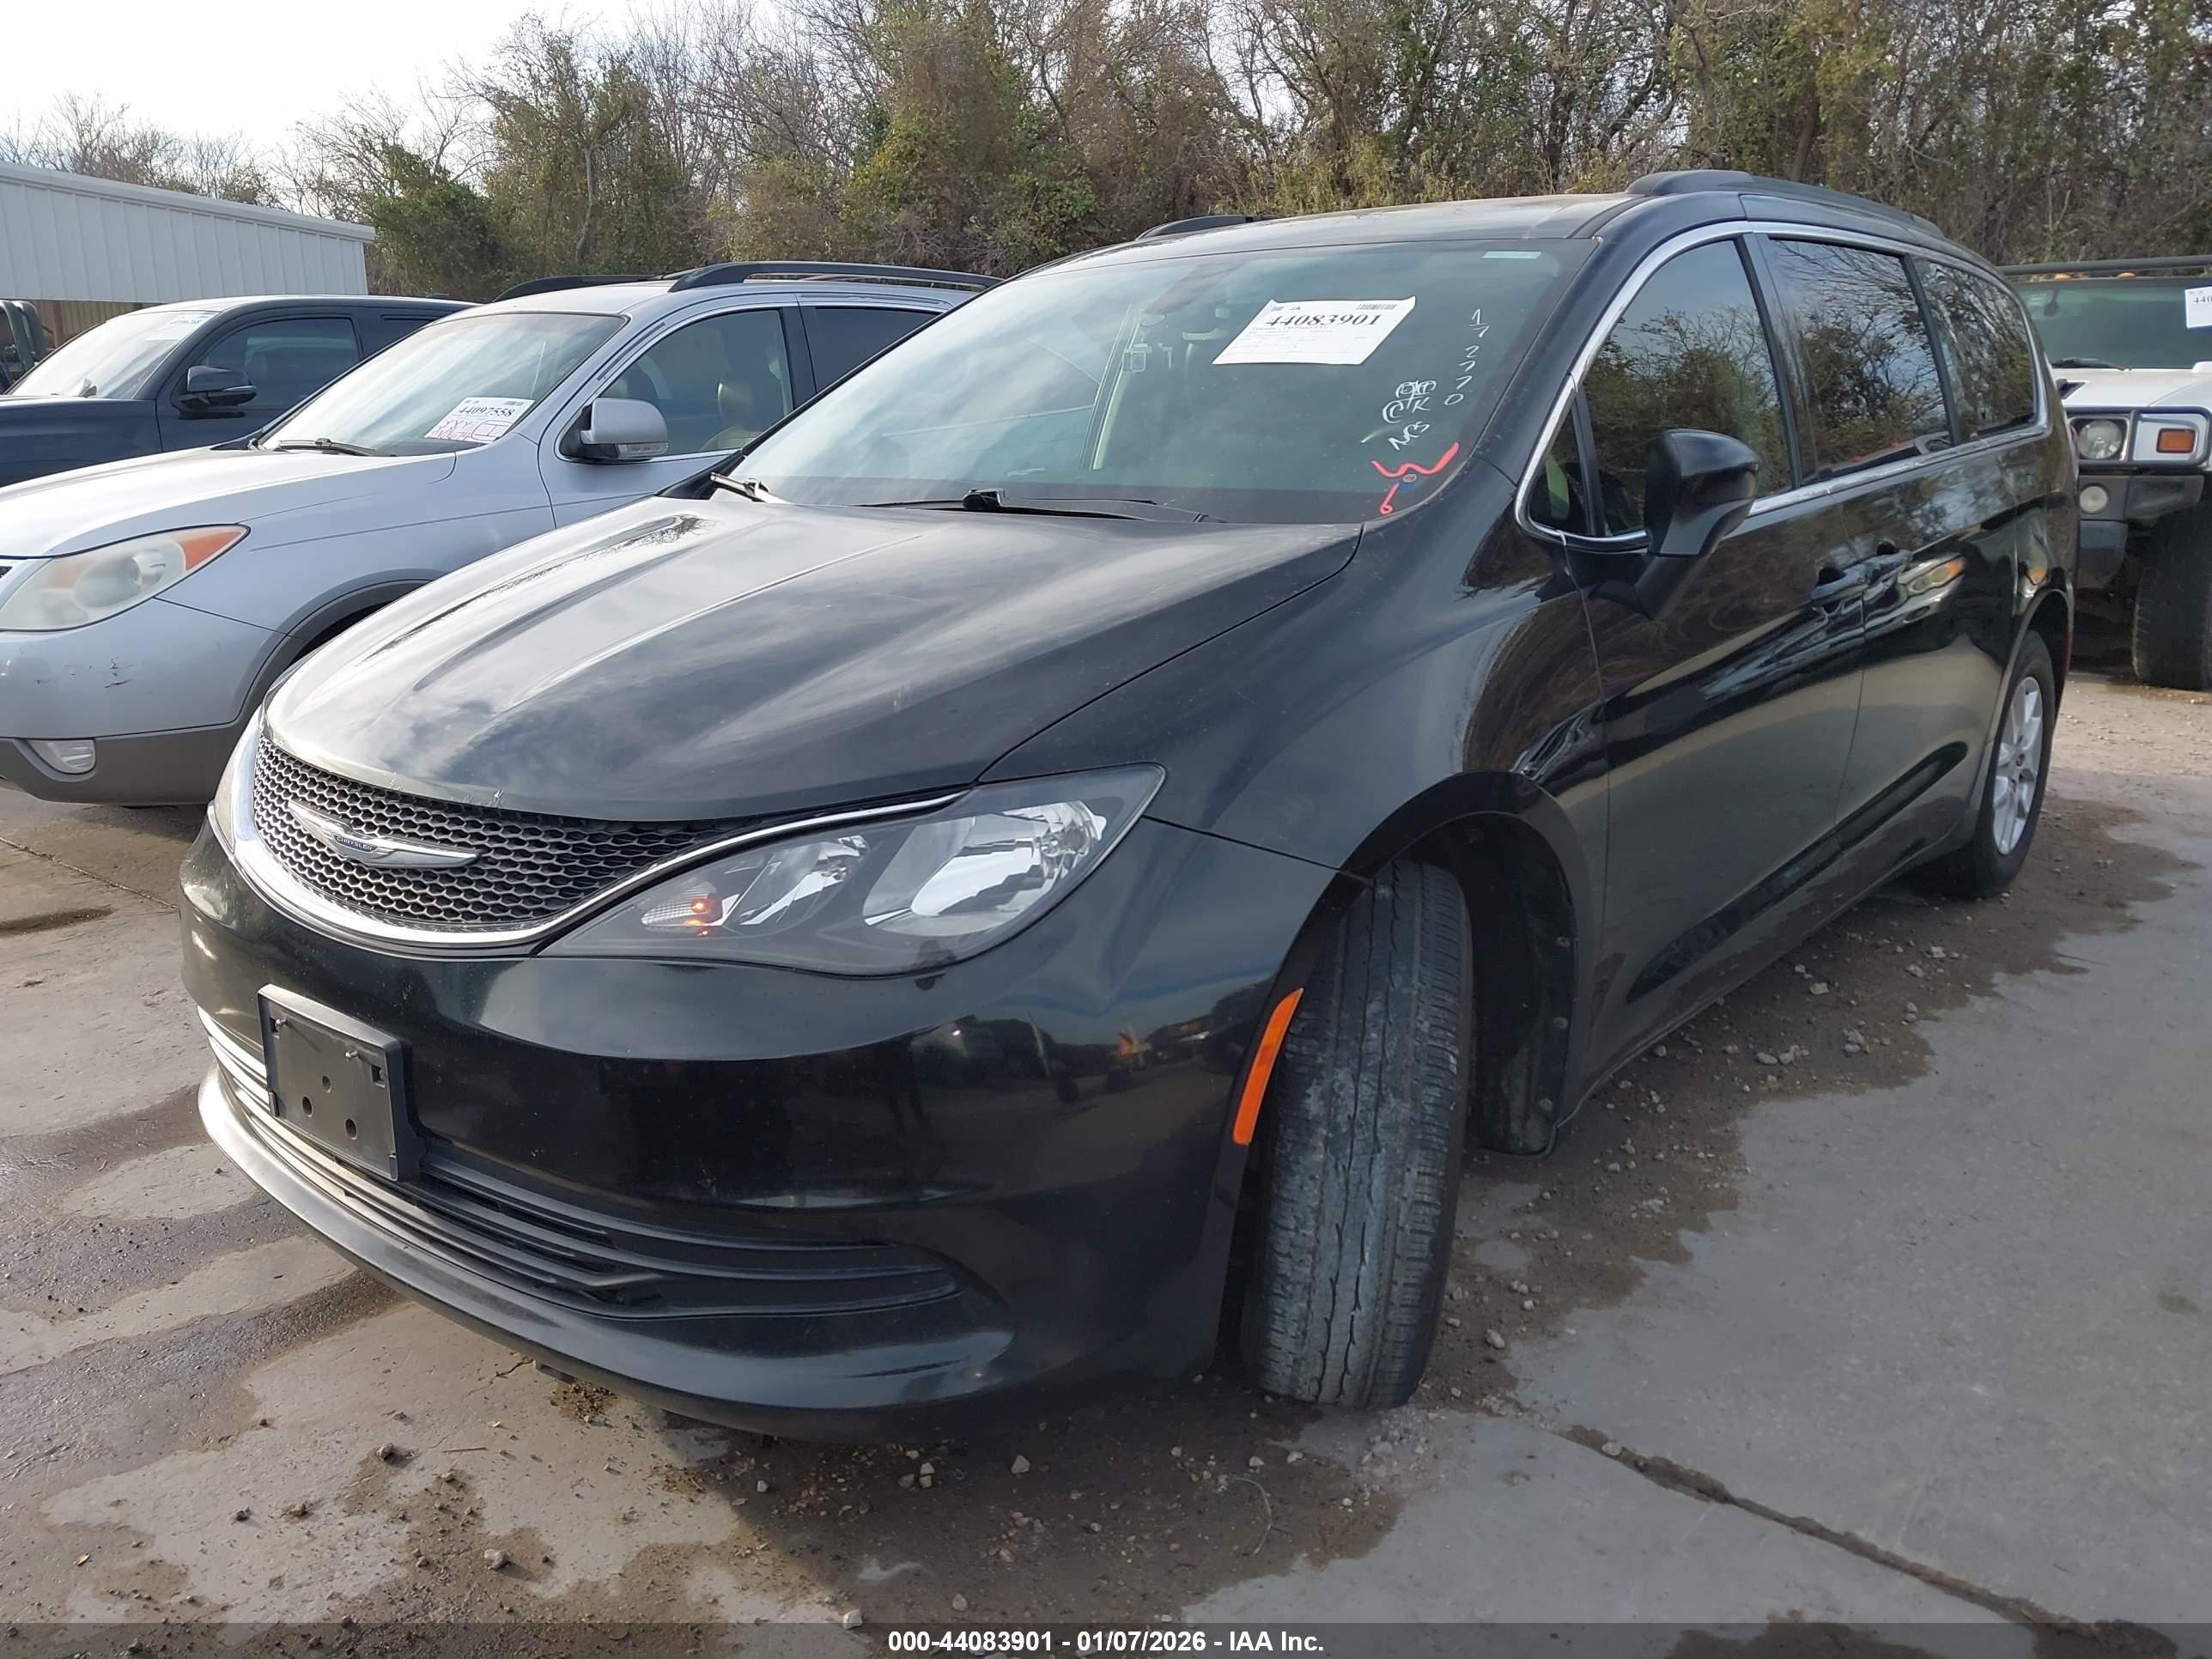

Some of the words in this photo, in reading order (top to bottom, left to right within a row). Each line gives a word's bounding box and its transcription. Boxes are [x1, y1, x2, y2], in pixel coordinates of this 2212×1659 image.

[1265, 313, 1382, 326] 44083901
[459, 406, 516, 417] 44097558
[337, 836, 374, 850] CHRYSLER
